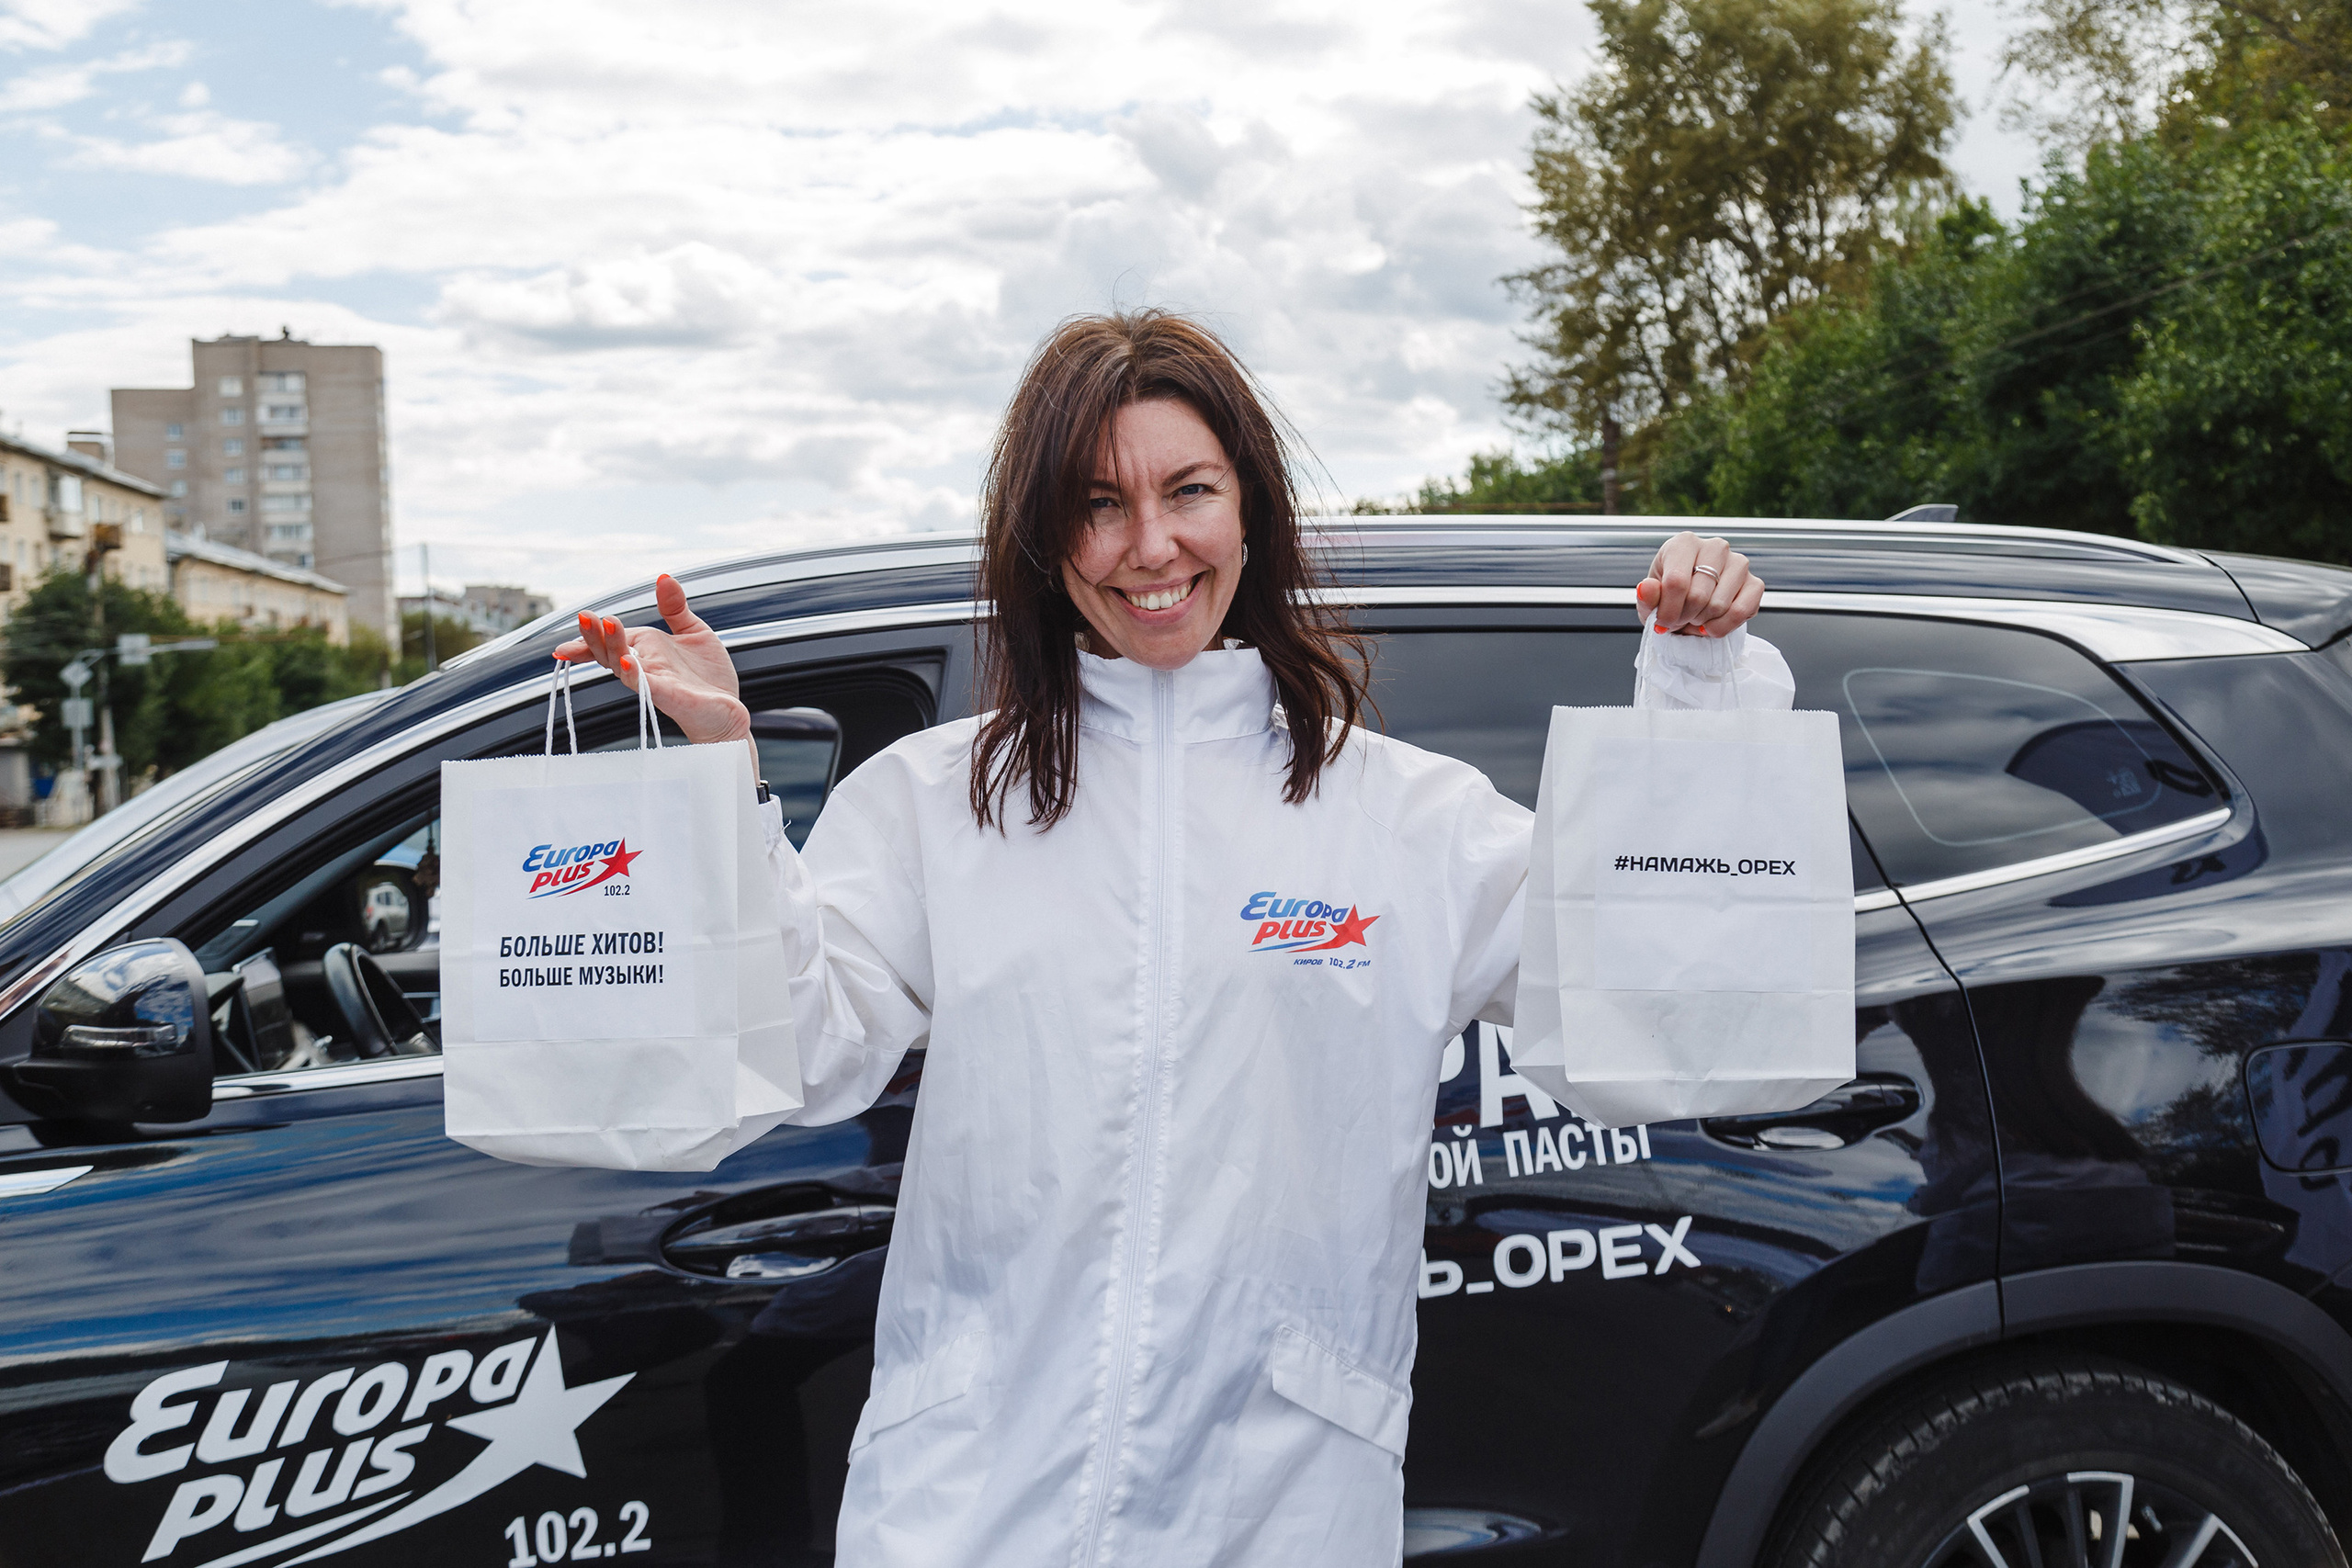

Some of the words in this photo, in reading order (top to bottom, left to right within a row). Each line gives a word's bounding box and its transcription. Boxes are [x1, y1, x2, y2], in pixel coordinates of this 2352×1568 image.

[1614, 855, 1796, 876] #НАМАЖЬ_ОРЕХ
[605, 885, 630, 897] 102.2
[501, 933, 586, 958] БОЛЬШЕ
[591, 931, 664, 956] ХИТОВ!
[1329, 957, 1356, 969] 102.2
[500, 966, 573, 987] БОЛЬШЕ
[579, 964, 664, 987] МУЗЫКИ!
[1502, 1122, 1652, 1179] ПАСТЫ
[505, 1501, 652, 1568] 102.2
